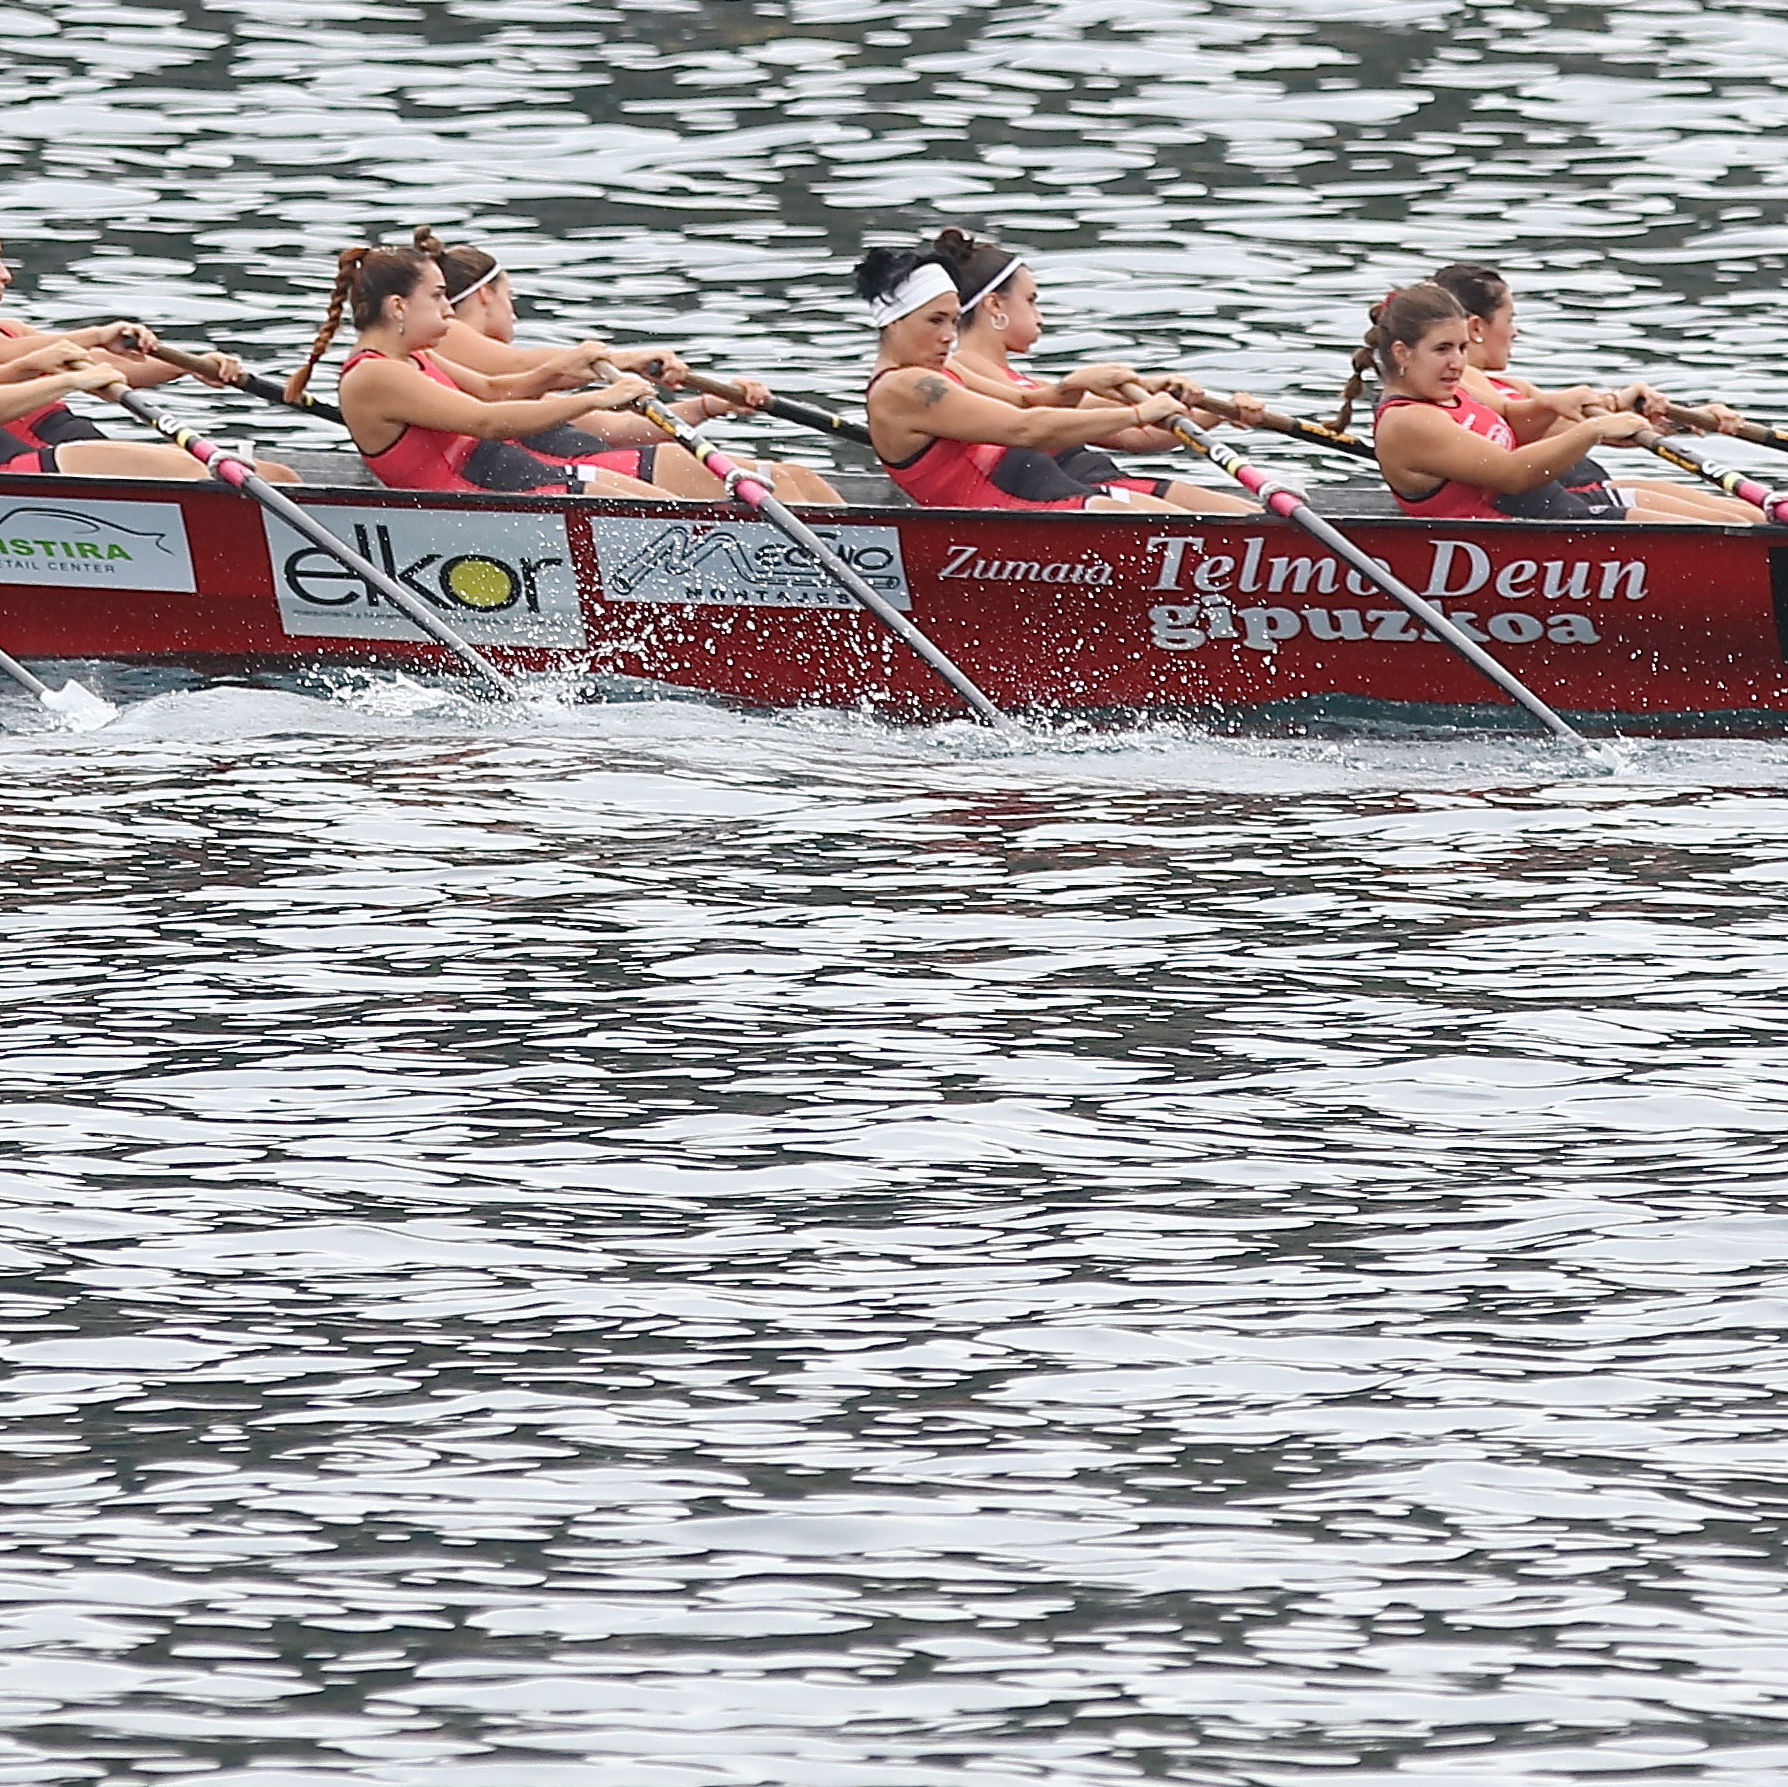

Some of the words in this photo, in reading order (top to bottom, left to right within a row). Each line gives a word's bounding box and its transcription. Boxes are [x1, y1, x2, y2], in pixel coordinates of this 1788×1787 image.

[48, 562, 116, 575] CENTER
[283, 523, 564, 614] elkor
[937, 545, 1114, 586] Zumaia
[1419, 539, 1649, 601] Deun
[1148, 594, 1602, 651] gipuzkoa
